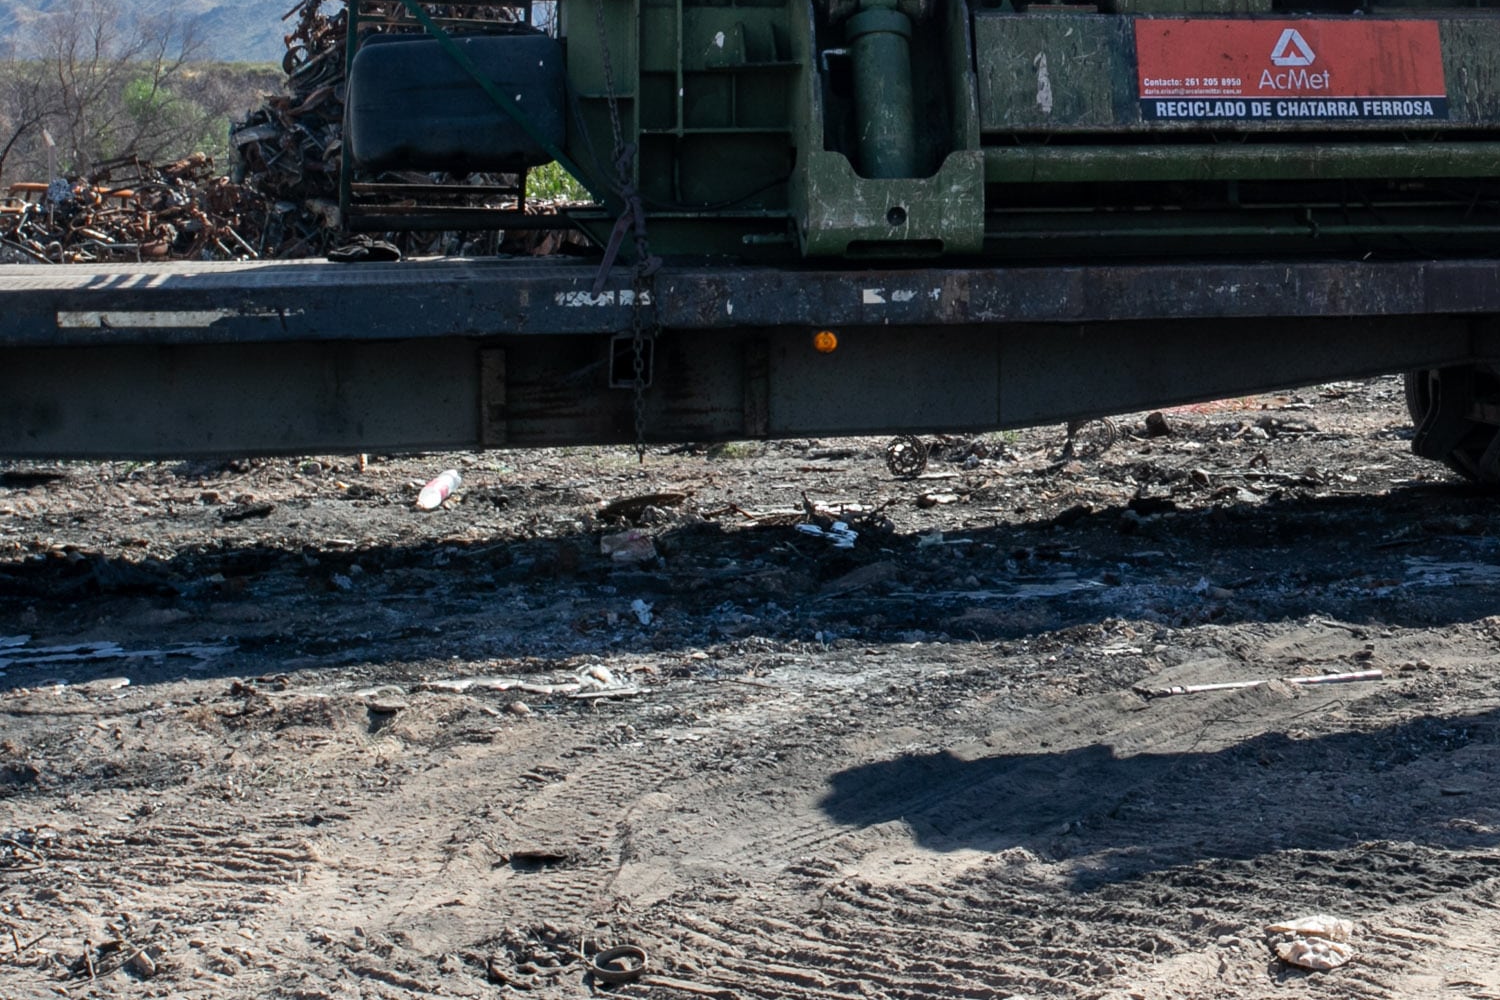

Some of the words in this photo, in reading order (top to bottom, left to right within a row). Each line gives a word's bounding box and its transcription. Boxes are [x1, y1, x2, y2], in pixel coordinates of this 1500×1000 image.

[1143, 78, 1182, 86] Contacto:
[1184, 78, 1200, 86] 261
[1203, 78, 1218, 86] 205
[1258, 69, 1330, 90] AcMet
[1156, 102, 1246, 117] RECICLADO
[1251, 102, 1272, 116] DE
[1277, 101, 1358, 116] CHATARRA
[1363, 101, 1433, 116] FERROSA
